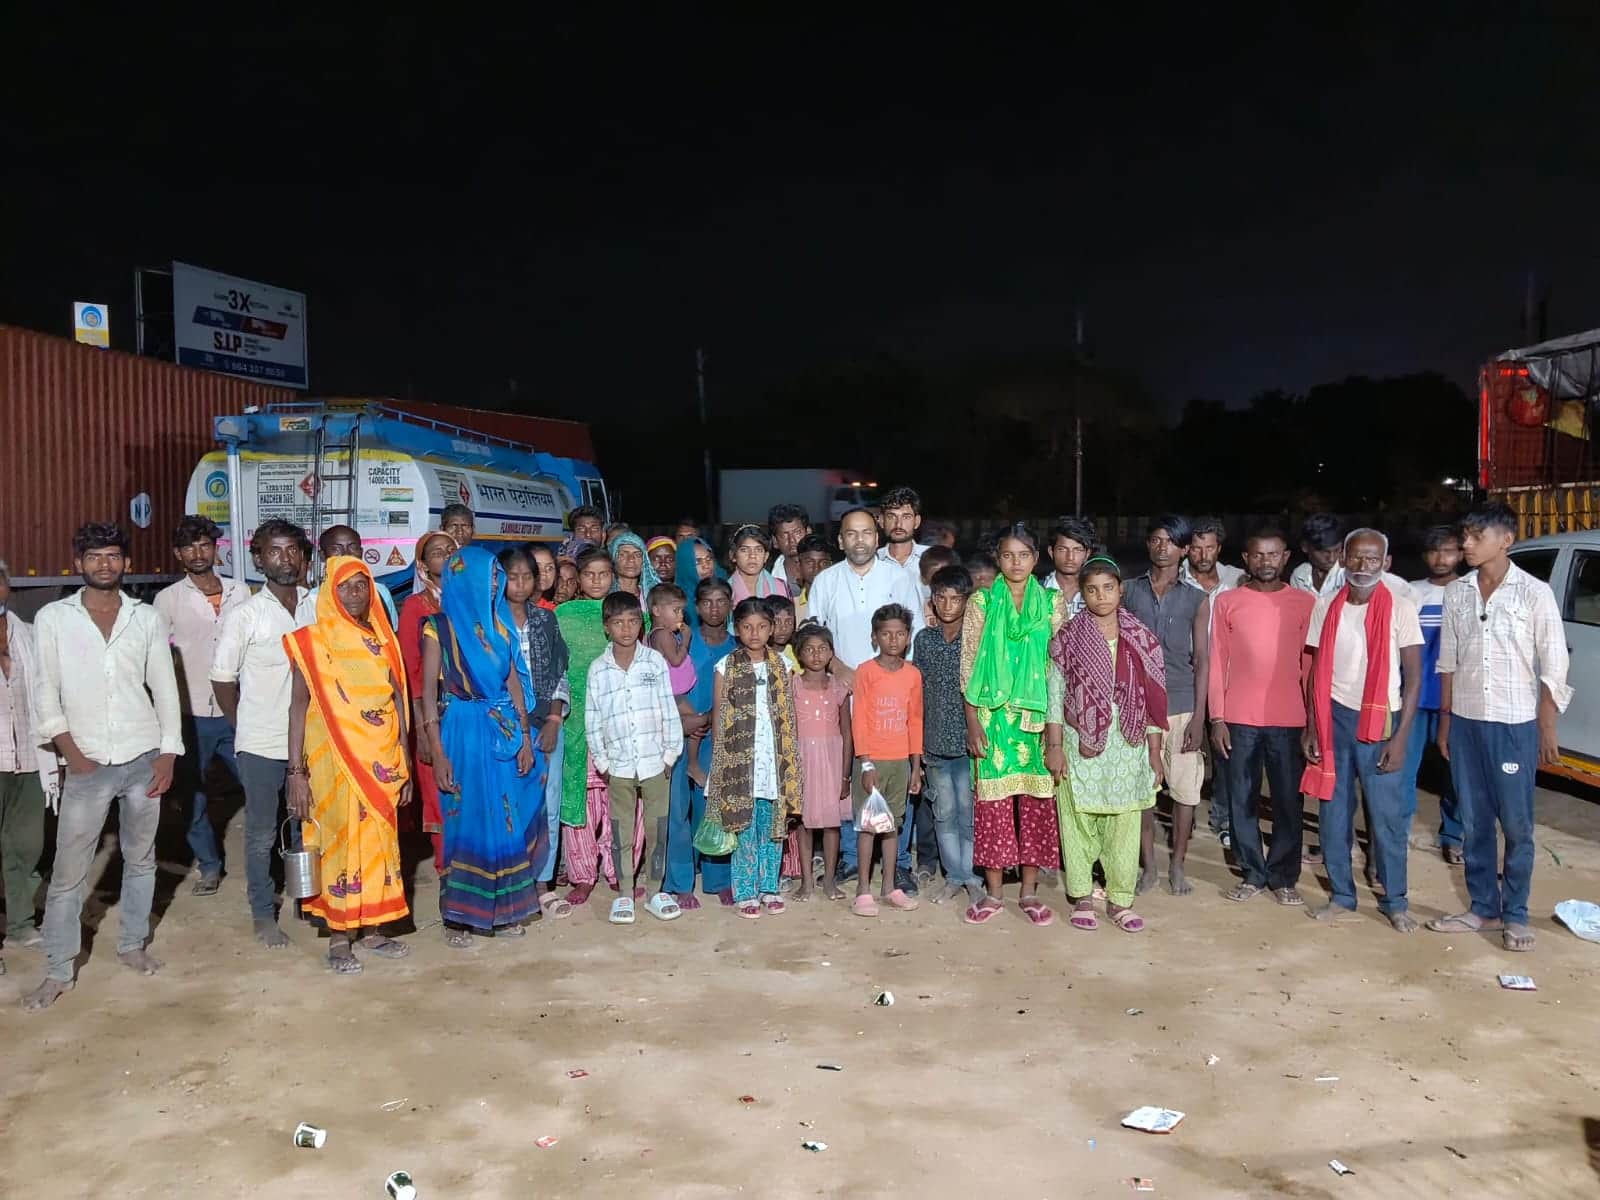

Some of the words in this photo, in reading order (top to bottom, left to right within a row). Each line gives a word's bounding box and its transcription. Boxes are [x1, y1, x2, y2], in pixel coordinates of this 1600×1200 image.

[228, 290, 250, 313] 3X
[368, 467, 400, 476] CAPACITY
[476, 483, 507, 503] भारत
